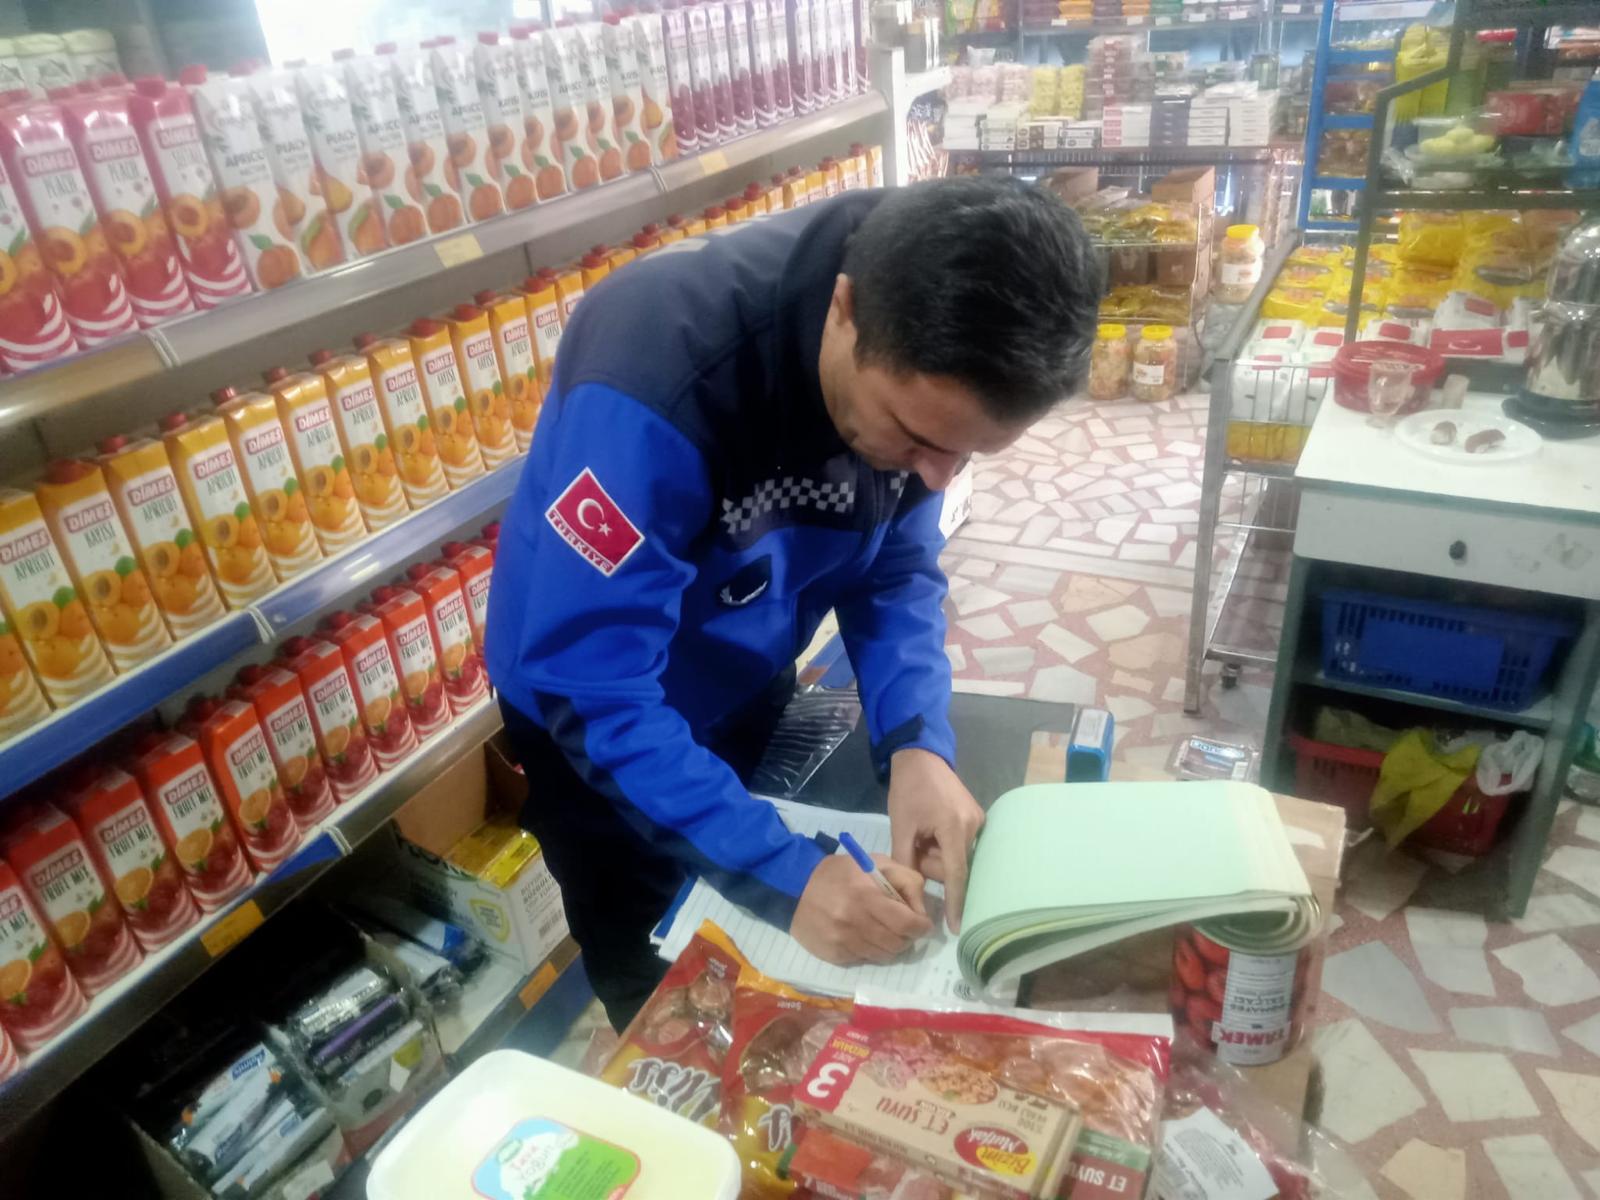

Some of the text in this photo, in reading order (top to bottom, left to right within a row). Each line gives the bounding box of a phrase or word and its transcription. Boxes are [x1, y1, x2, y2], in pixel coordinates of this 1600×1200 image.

[225, 151, 265, 168] APRICO
[806, 1062, 850, 1098] 3
[921, 1115, 950, 1136] ET
[967, 1128, 1022, 1152] Mutfak
[980, 1145, 1032, 1175] Bizim
[1107, 1174, 1128, 1193] ET
